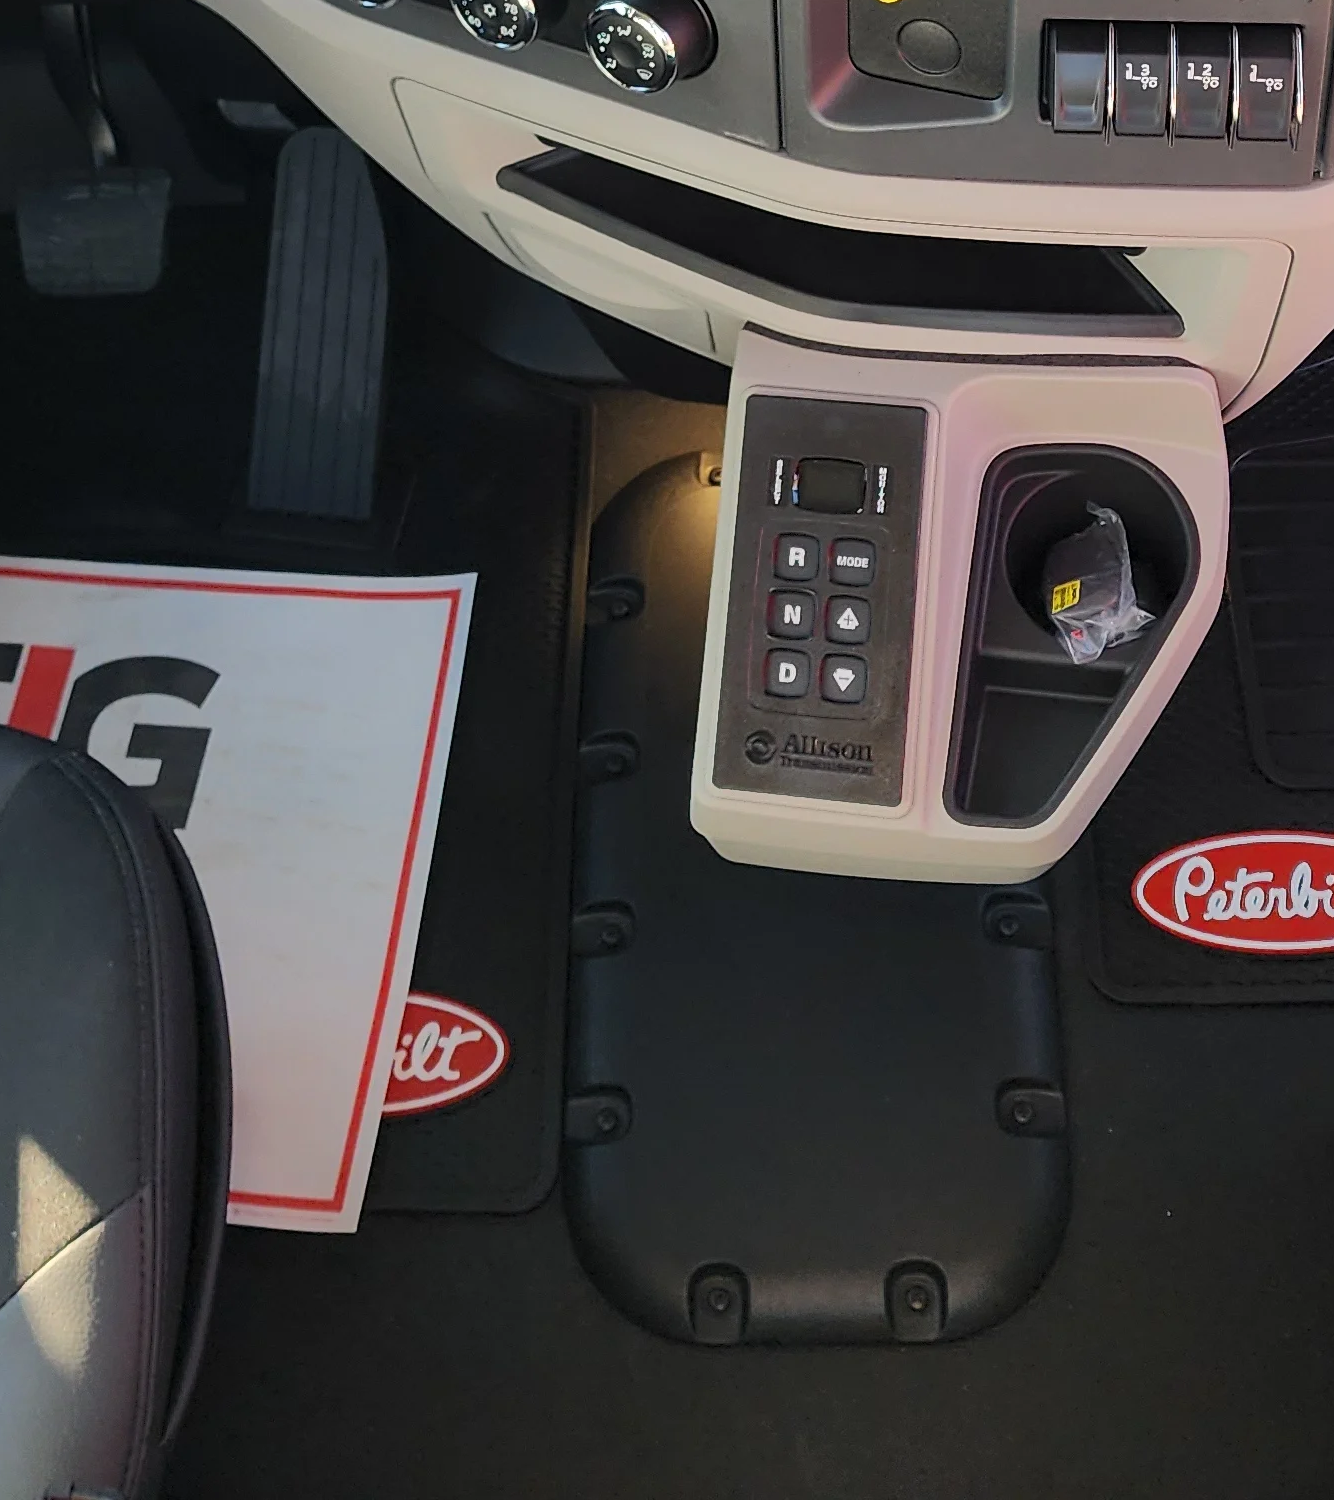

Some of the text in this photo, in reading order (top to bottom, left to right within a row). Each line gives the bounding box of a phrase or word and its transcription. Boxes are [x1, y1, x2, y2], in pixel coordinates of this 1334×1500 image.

[1141, 64, 1150, 76] 3
[1203, 64, 1212, 76] 2
[789, 547, 806, 567] R
[837, 556, 869, 568] MODE
[784, 604, 802, 625] N
[779, 662, 797, 684] D
[781, 733, 873, 762] Allison
